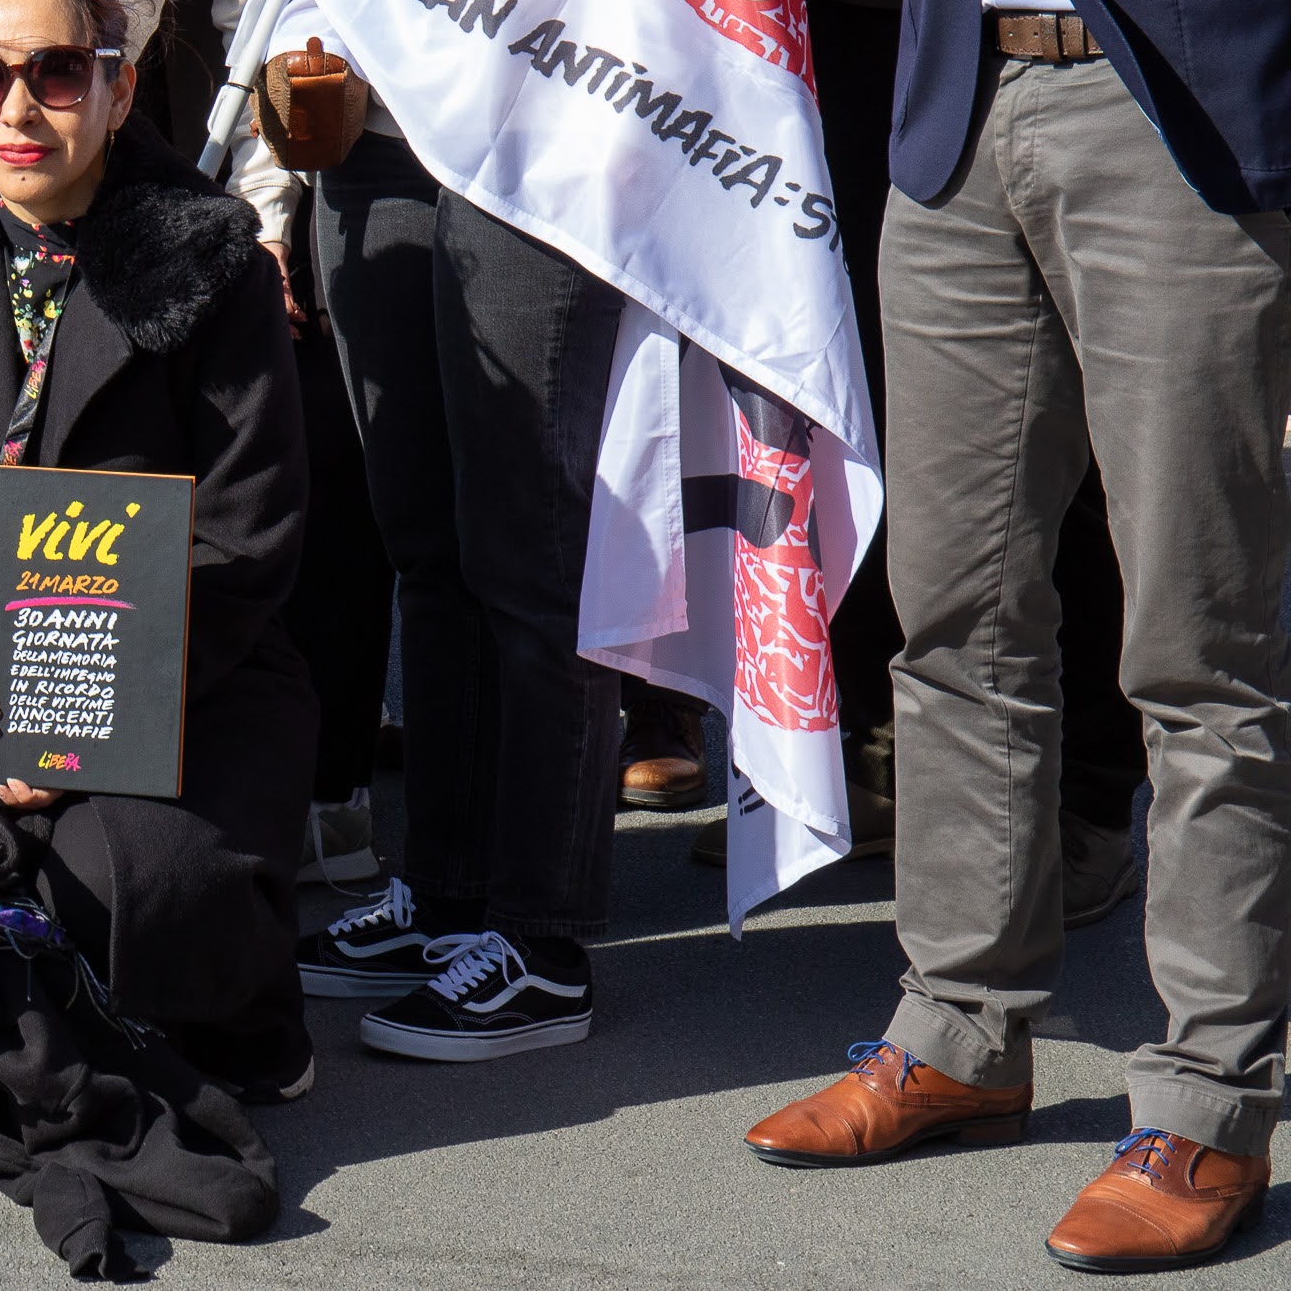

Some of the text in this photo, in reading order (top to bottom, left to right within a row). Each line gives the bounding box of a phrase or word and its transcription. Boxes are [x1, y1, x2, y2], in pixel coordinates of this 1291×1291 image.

[16, 571, 119, 595] 21 MARZO
[14, 608, 118, 630] 30 ANNI
[12, 629, 119, 650] GIORNATA
[12, 649, 117, 668] DELLA MEMORIA
[11, 679, 115, 699] IN RICORDO
[9, 694, 114, 710] DELLE VITTIME
[9, 707, 114, 726] INNOCENTI
[7, 721, 113, 739] DELLE MAFIE
